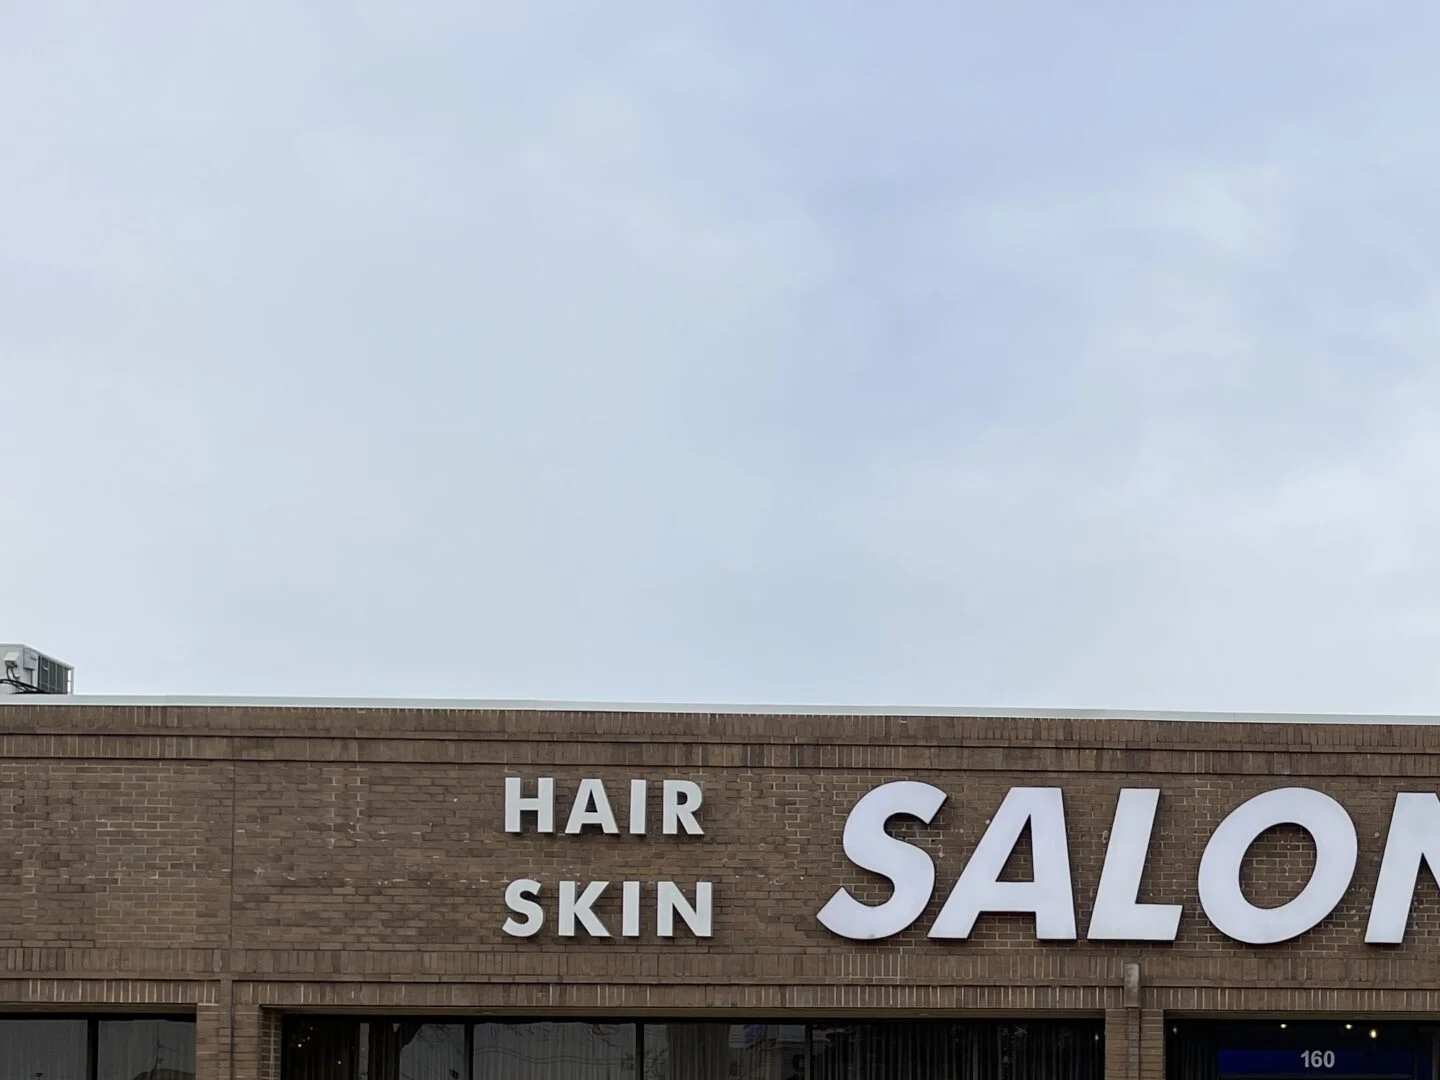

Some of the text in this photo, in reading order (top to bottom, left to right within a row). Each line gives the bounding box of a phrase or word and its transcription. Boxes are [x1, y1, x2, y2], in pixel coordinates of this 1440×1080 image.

[503, 777, 706, 836] HAIR
[502, 878, 714, 938] SKIN
[1300, 1050, 1335, 1068] 160
